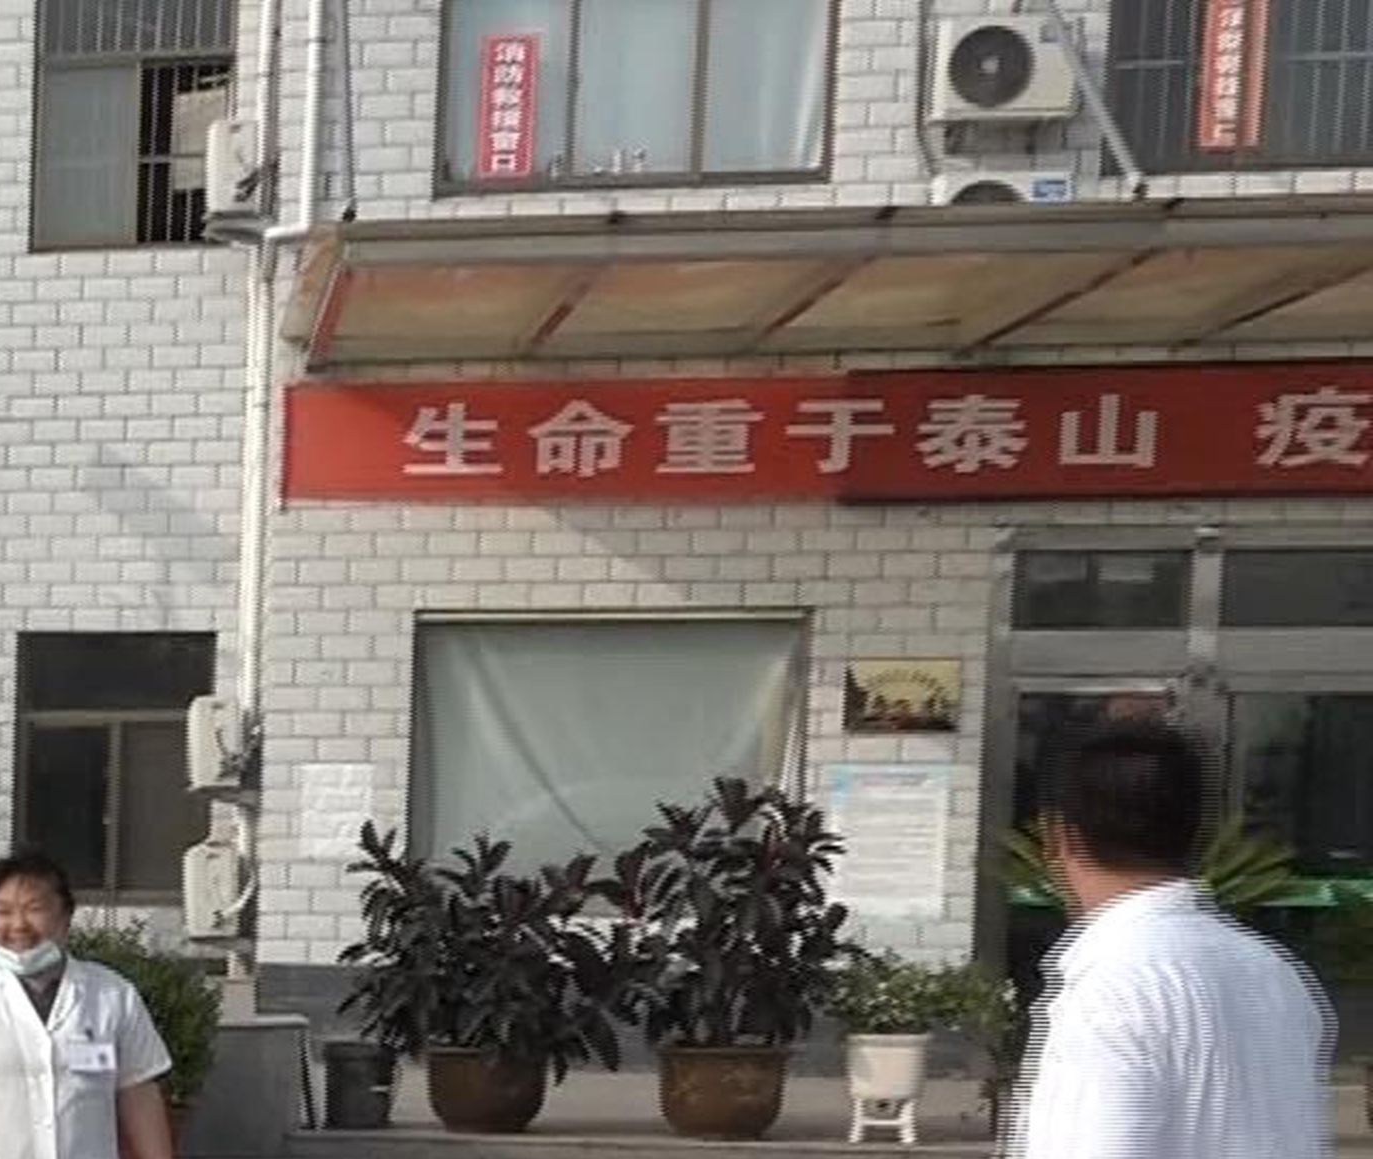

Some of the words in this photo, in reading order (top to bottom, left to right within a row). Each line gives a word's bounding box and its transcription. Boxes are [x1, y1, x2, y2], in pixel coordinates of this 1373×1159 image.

[403, 395, 1158, 477] 生命重于泰山
[1254, 386, 1372, 468] 疫
